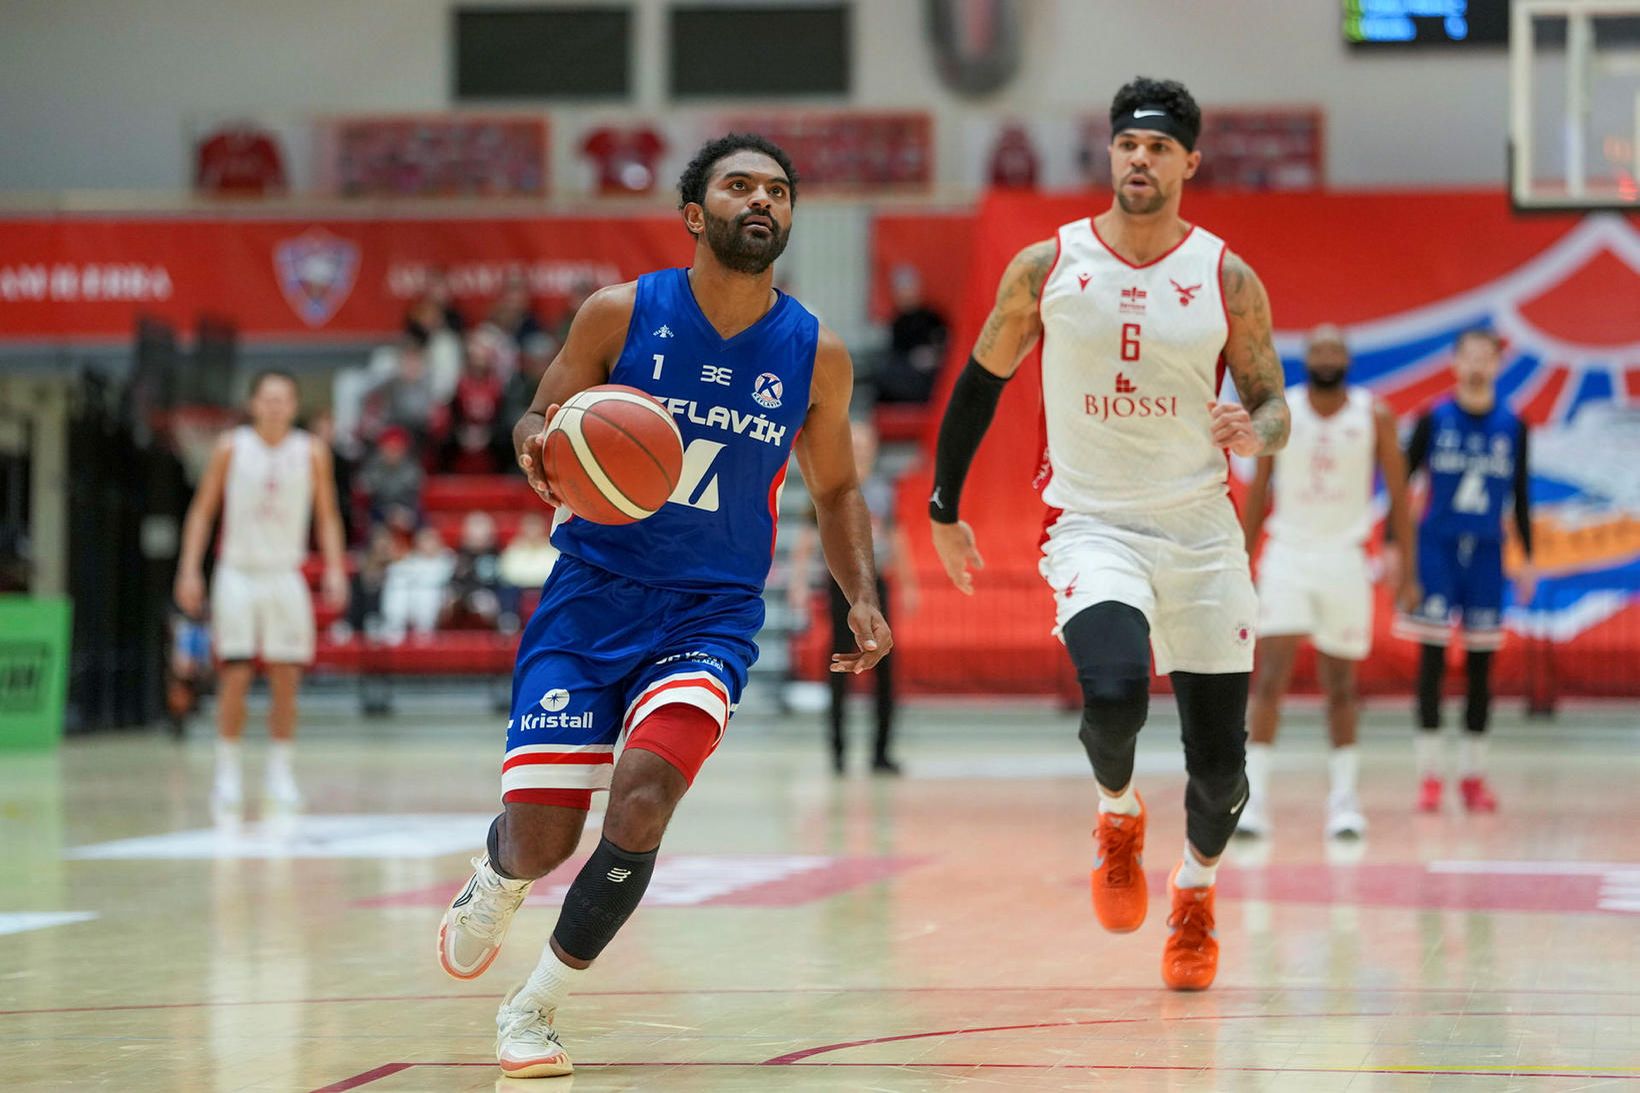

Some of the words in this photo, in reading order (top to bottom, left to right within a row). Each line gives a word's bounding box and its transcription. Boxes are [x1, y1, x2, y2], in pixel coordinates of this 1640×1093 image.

[1120, 323, 1141, 362] 6
[652, 354, 665, 380] 1
[651, 396, 786, 446] FLAVÍK
[520, 711, 594, 732] Kristall
